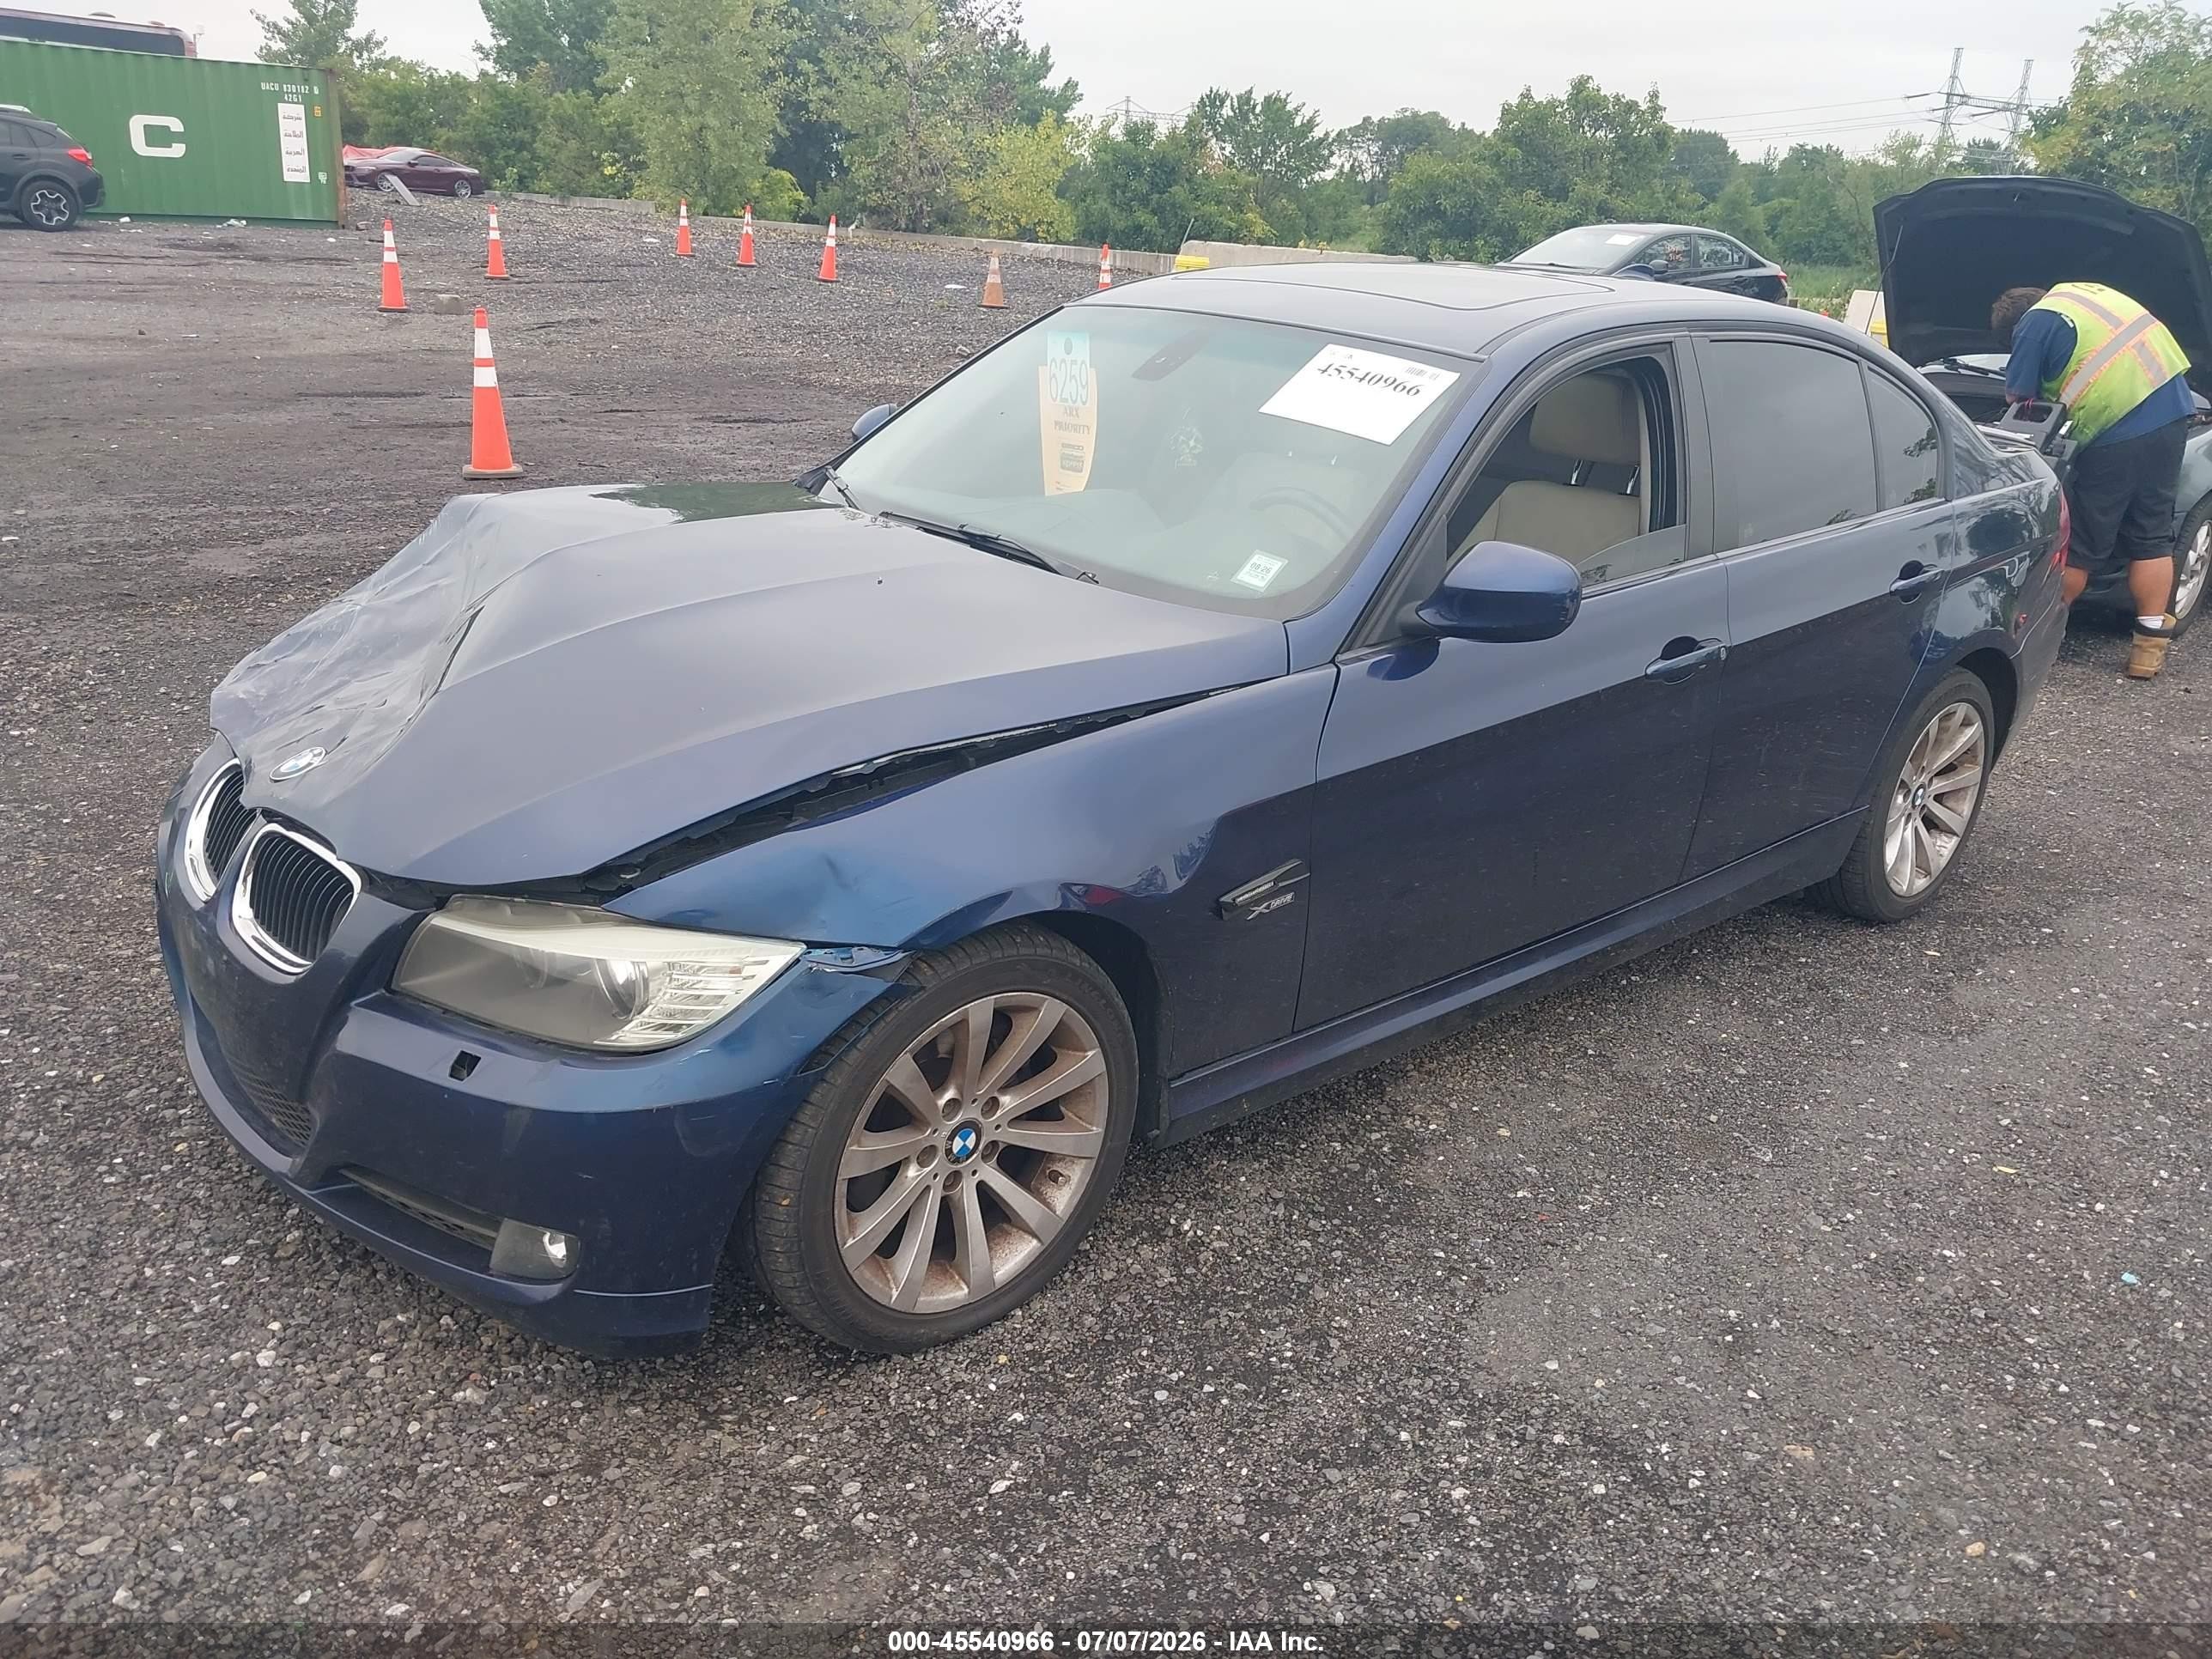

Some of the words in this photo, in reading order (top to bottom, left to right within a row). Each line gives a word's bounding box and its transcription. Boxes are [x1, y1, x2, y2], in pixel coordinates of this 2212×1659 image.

[261, 82, 279, 91] UACU
[130, 115, 185, 158] C
[1049, 357, 1089, 406] 6259
[1317, 362, 1425, 397] 45540966
[1054, 420, 1091, 434] PRIORITY
